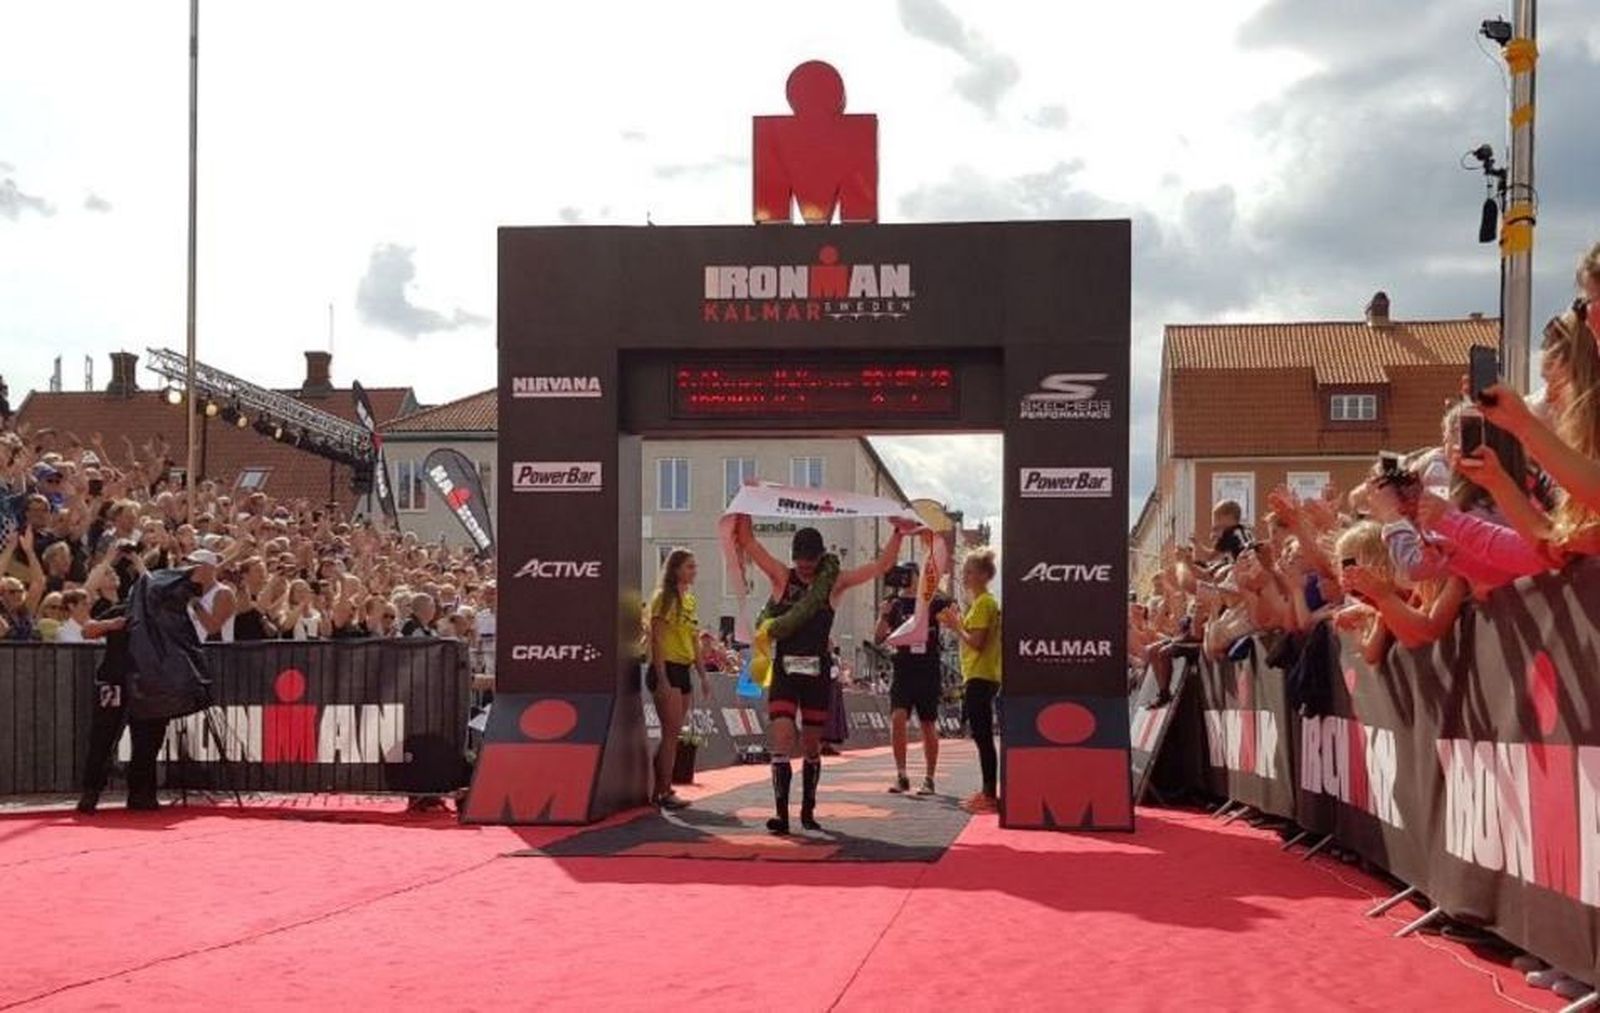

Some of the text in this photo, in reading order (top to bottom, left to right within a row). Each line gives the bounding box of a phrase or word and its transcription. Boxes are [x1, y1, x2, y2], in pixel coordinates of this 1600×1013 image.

[704, 246, 911, 299] IRONMAN
[703, 301, 911, 321] KALMAR SWEDEN
[512, 376, 601, 393] NIRVANA
[1020, 400, 1111, 411] SKECHERS
[1020, 410, 1111, 419] PERFORMANCE
[517, 465, 596, 484] PowerBar
[1024, 470, 1107, 489] PowerBar
[777, 497, 858, 514] IRONMA
[752, 520, 797, 533] candia
[513, 558, 602, 578] ACTIVE
[1021, 562, 1112, 581] ACTIVE
[512, 644, 582, 660] CRAFT
[1019, 639, 1112, 656] KALMAR
